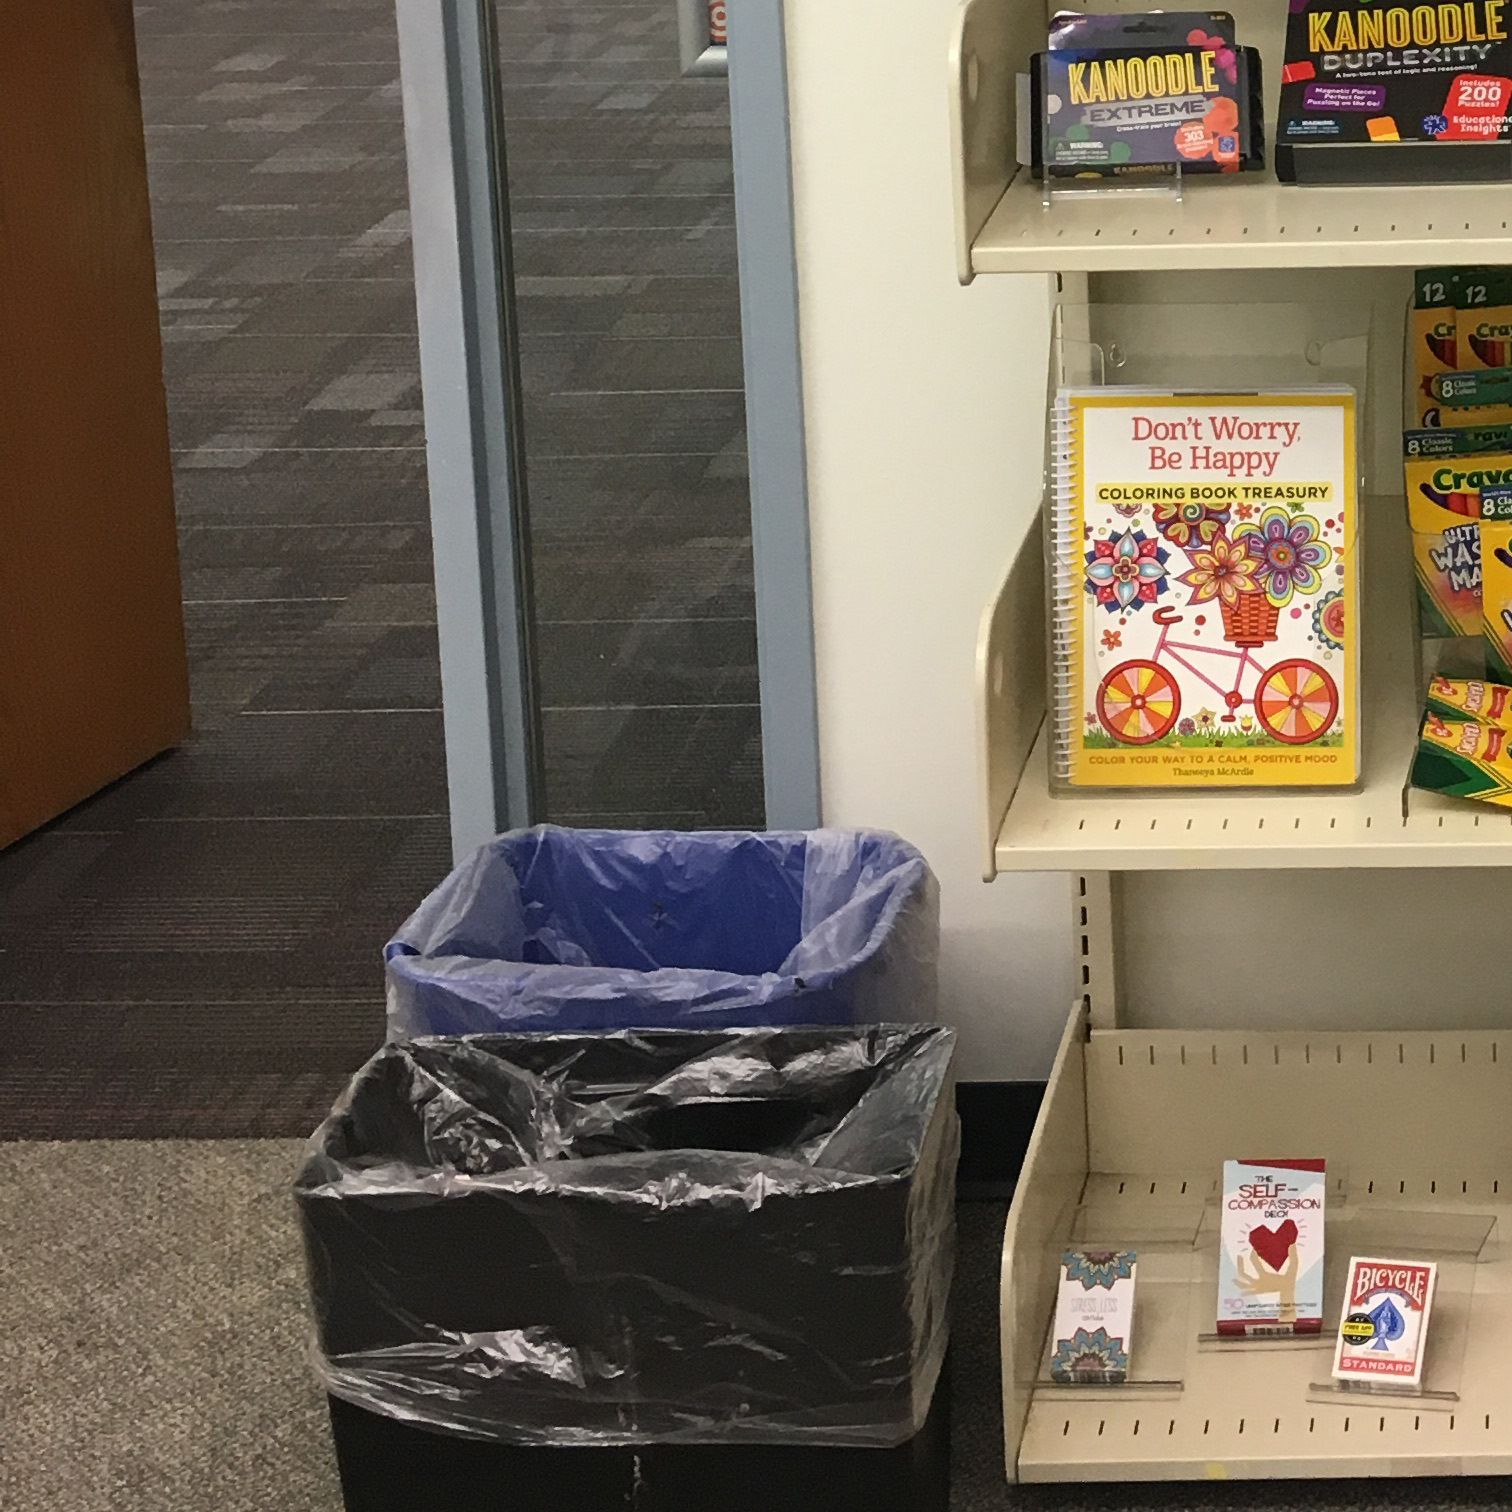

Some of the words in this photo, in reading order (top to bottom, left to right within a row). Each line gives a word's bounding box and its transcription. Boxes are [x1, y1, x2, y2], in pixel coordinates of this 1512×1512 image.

[1309, 0, 1507, 52] KANOODLE
[1323, 44, 1492, 70] DUPLEXITY
[1069, 51, 1219, 105] KANOODLE
[1459, 79, 1501, 87] Includes
[1458, 87, 1501, 101] 200
[1090, 100, 1205, 122] EXTREME
[1184, 130, 1204, 143] 303
[1461, 124, 1509, 135] Insights
[1423, 283, 1446, 303] 12
[1466, 286, 1488, 304] 12
[1441, 380, 1454, 398] 8
[1132, 416, 1202, 441] Don't
[1208, 416, 1301, 447] Worry,
[1407, 438, 1421, 455] 8
[1149, 446, 1182, 470] Be
[1190, 446, 1280, 477] Happy
[1099, 487, 1185, 500] COLORING
[1190, 487, 1237, 499] BOOK
[1242, 486, 1329, 499] TREASURY
[1482, 499, 1495, 514] 8
[1089, 755, 1126, 764] COLOR
[1129, 755, 1159, 764] YOUR
[1162, 755, 1185, 764] WAY
[1189, 755, 1204, 764] TO
[1207, 755, 1215, 764] A
[1253, 754, 1302, 764] POSITIVE
[1304, 754, 1337, 764] MOOD
[1255, 1175, 1274, 1183] THE
[1227, 1198, 1322, 1211] COMPASSION
[1264, 1210, 1289, 1219] DECK
[1353, 1267, 1426, 1307] BICYCLE
[1342, 1358, 1413, 1373] STANDARD
